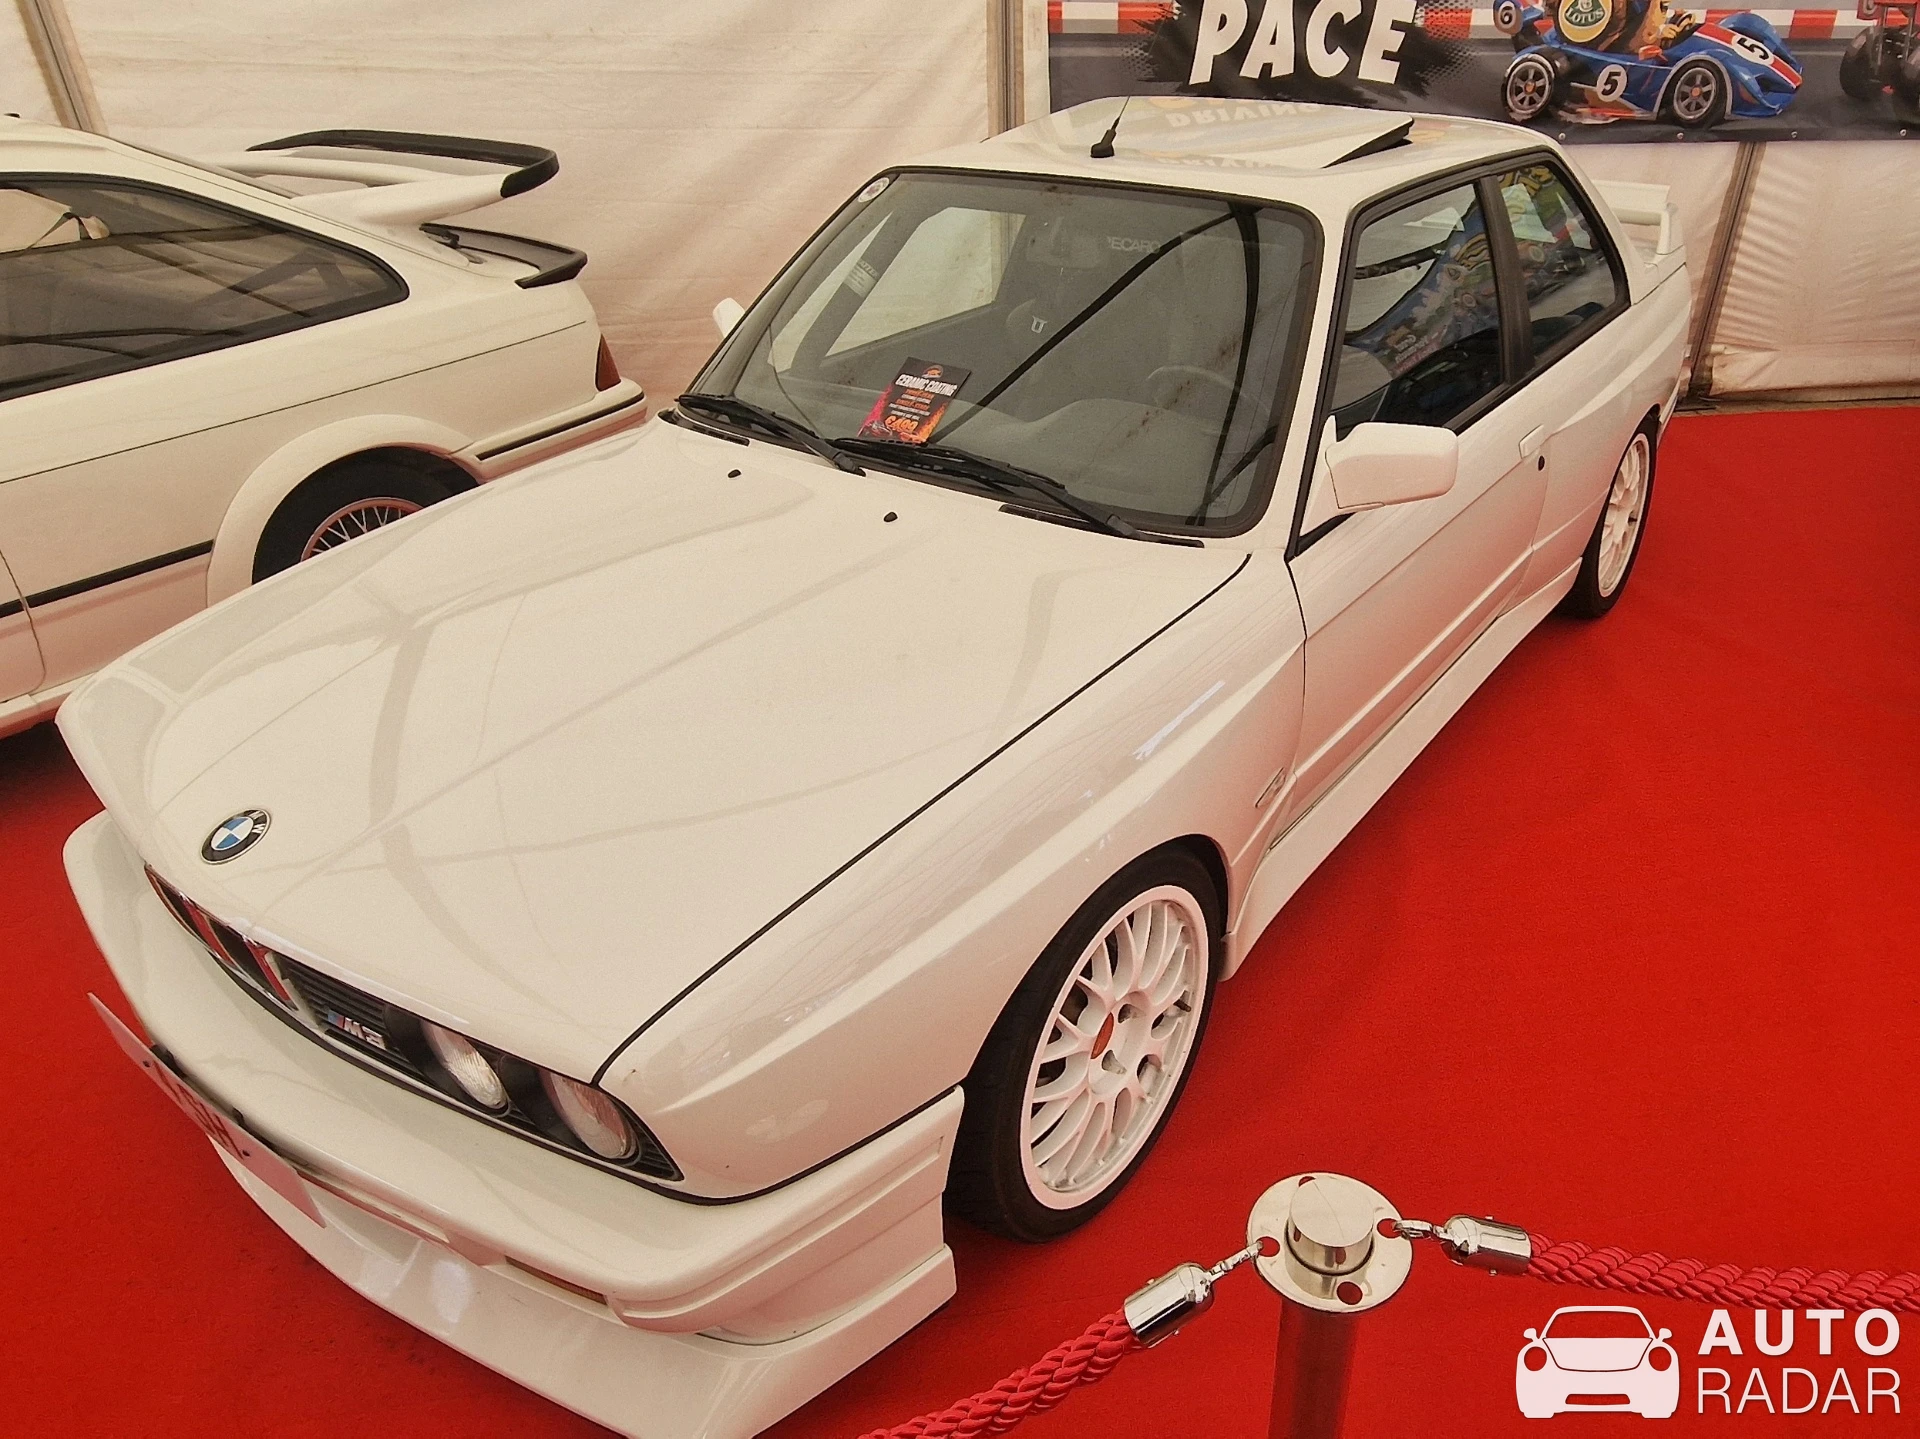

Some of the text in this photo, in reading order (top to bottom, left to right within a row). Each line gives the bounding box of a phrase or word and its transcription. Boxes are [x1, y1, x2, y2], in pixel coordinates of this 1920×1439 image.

[1565, 7, 1605, 24] LOTUS
[1189, 0, 1417, 85] PACE
[1737, 36, 1771, 61] 5
[1601, 71, 1621, 96] 5
[1106, 235, 1161, 253] ECARO
[895, 373, 930, 390] CERAMIC
[924, 380, 958, 397] COATING
[344, 1016, 387, 1051] M3
